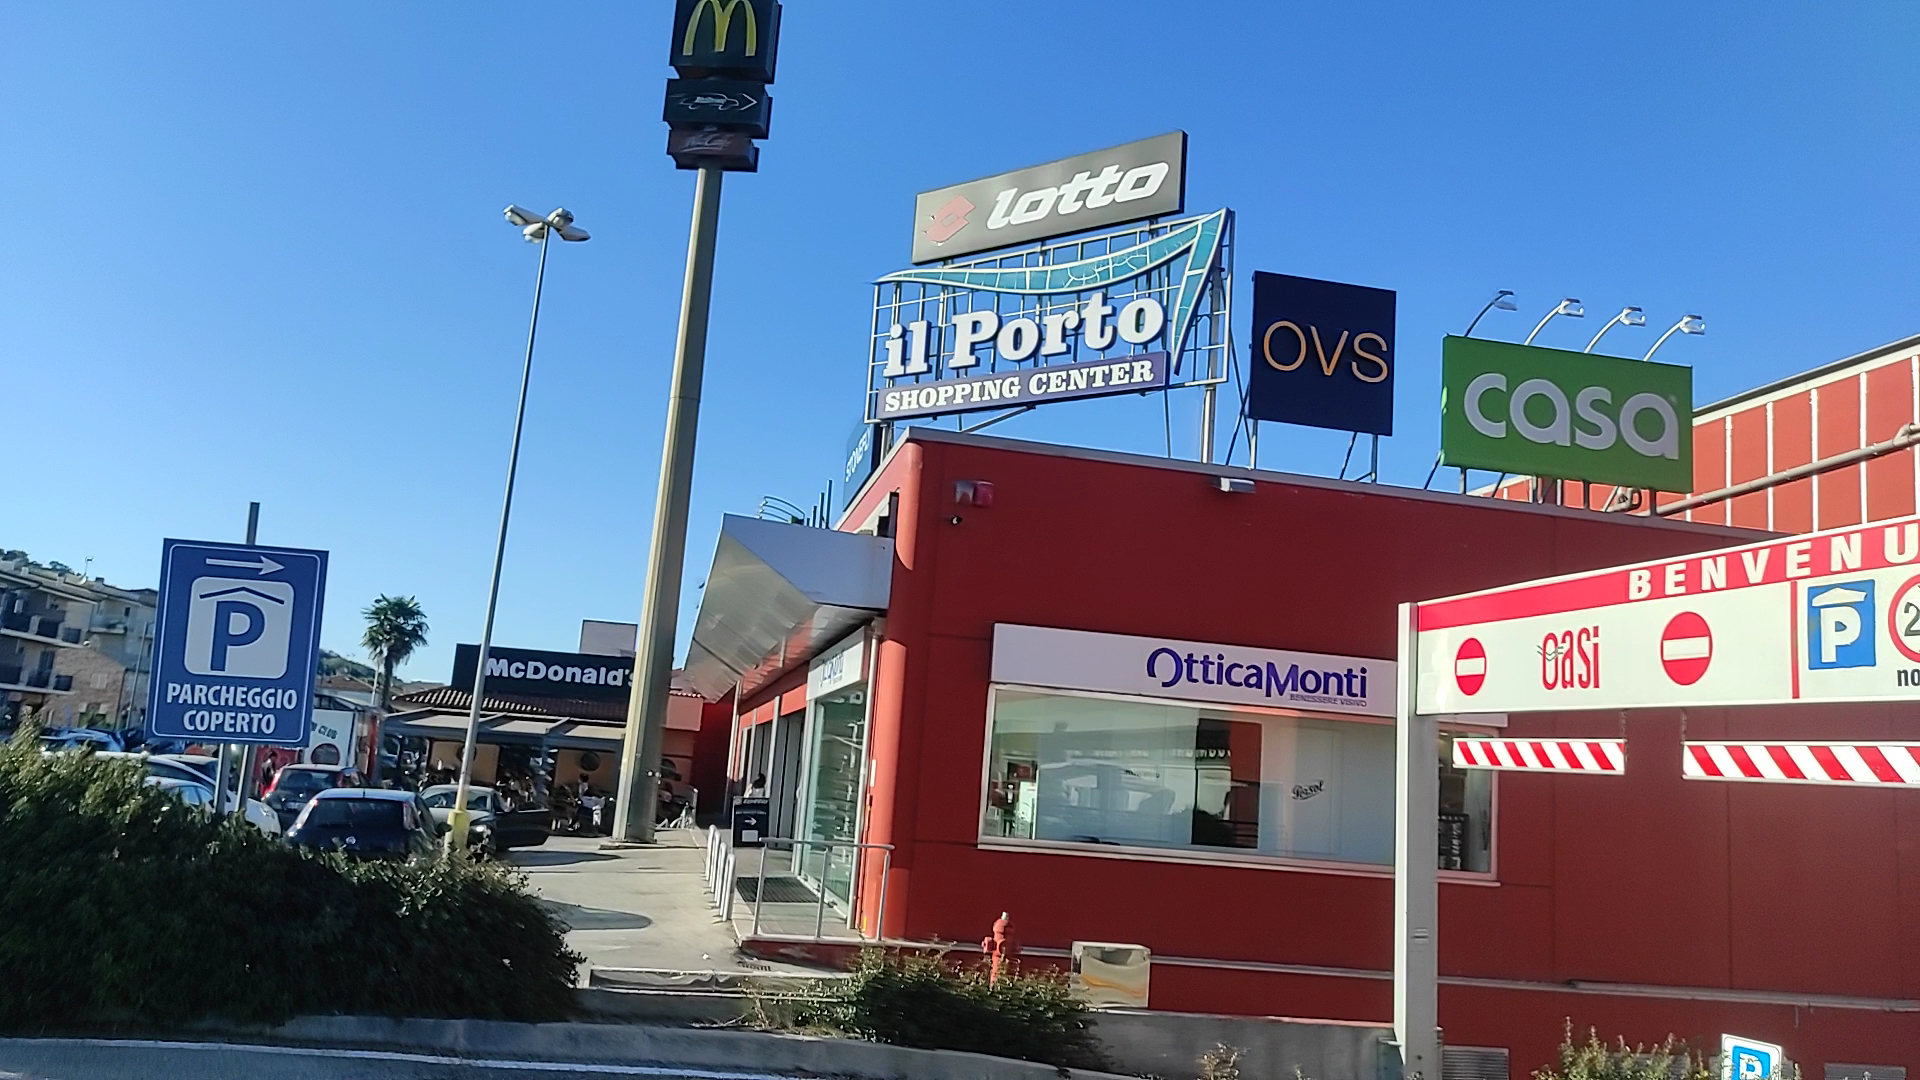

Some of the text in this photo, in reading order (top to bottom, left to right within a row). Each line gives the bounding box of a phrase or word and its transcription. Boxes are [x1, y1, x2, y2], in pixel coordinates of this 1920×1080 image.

[986, 161, 1170, 230] lotto
[882, 291, 1165, 378] il Porto
[1263, 320, 1389, 383] OVS
[884, 359, 1155, 412] SHOPPING CENTER
[1463, 373, 1680, 460] casa
[166, 682, 298, 710] PARCHEGGIO
[183, 709, 276, 735] COPERTO
